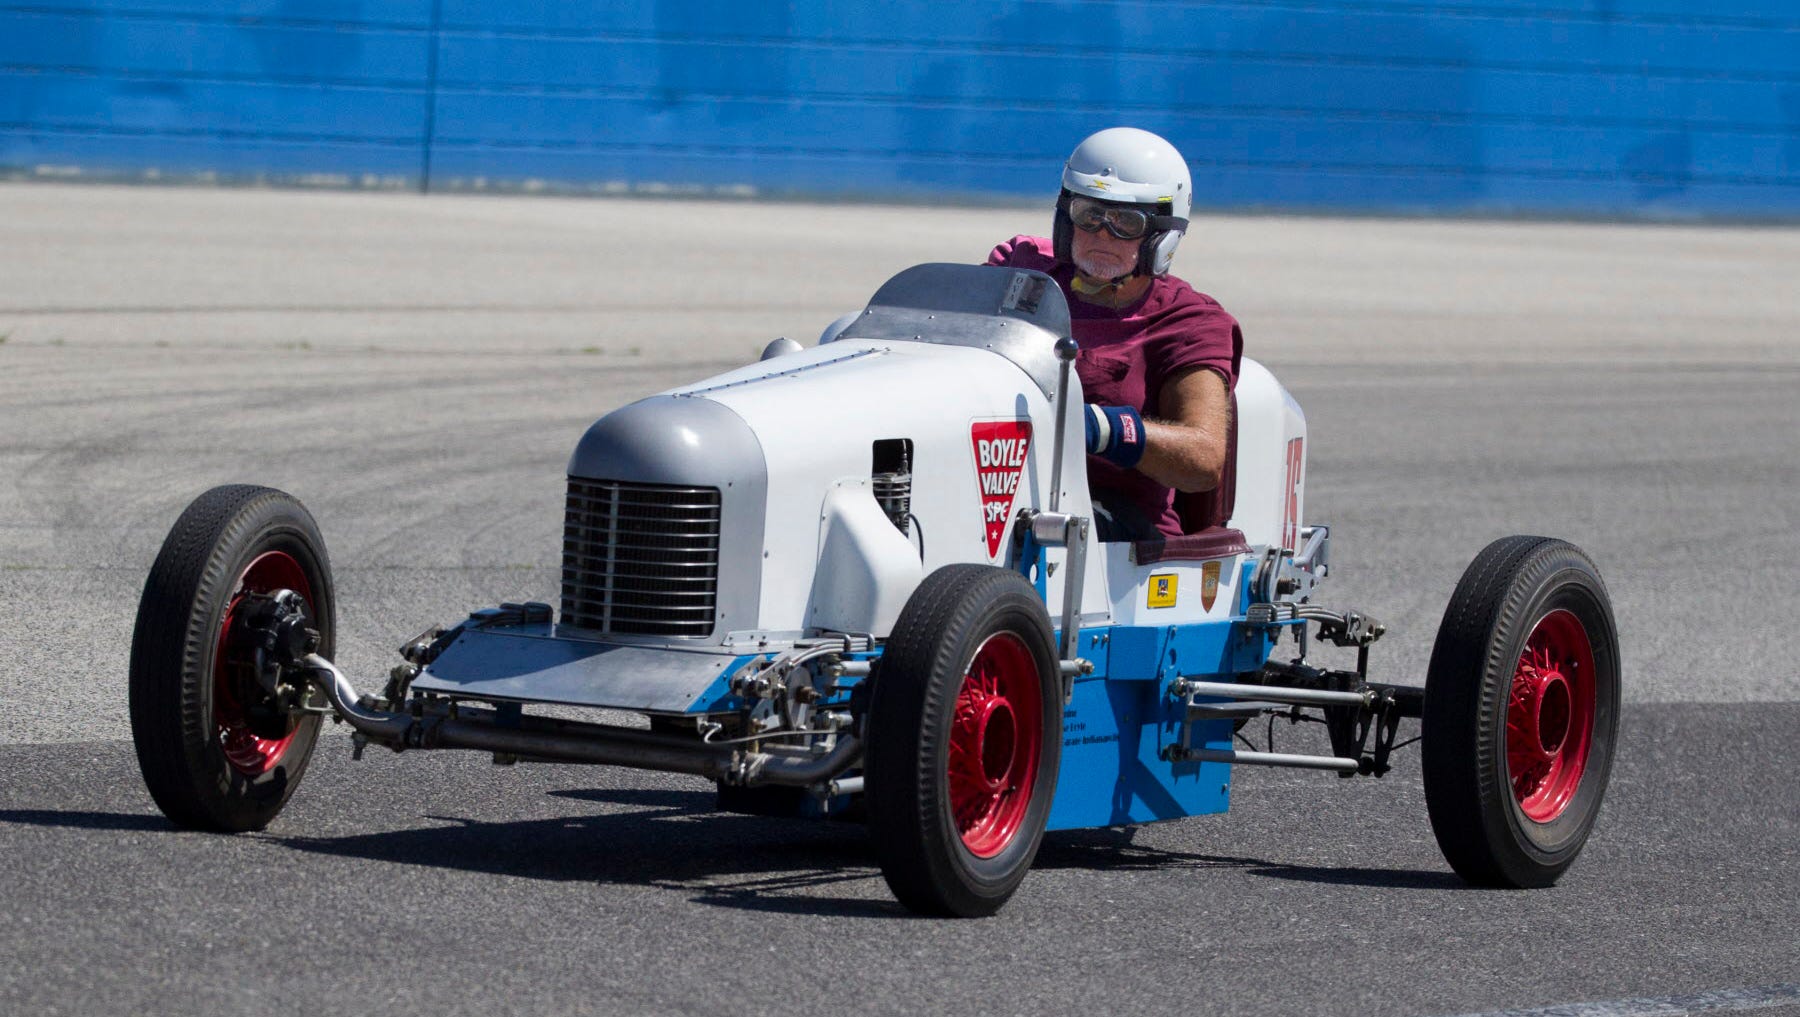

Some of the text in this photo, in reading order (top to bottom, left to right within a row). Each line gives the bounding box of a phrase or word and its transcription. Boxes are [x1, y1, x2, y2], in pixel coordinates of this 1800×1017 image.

[978, 438, 1027, 467] BOYLE
[980, 472, 1019, 496] VALVE
[986, 501, 1009, 522] SPC
